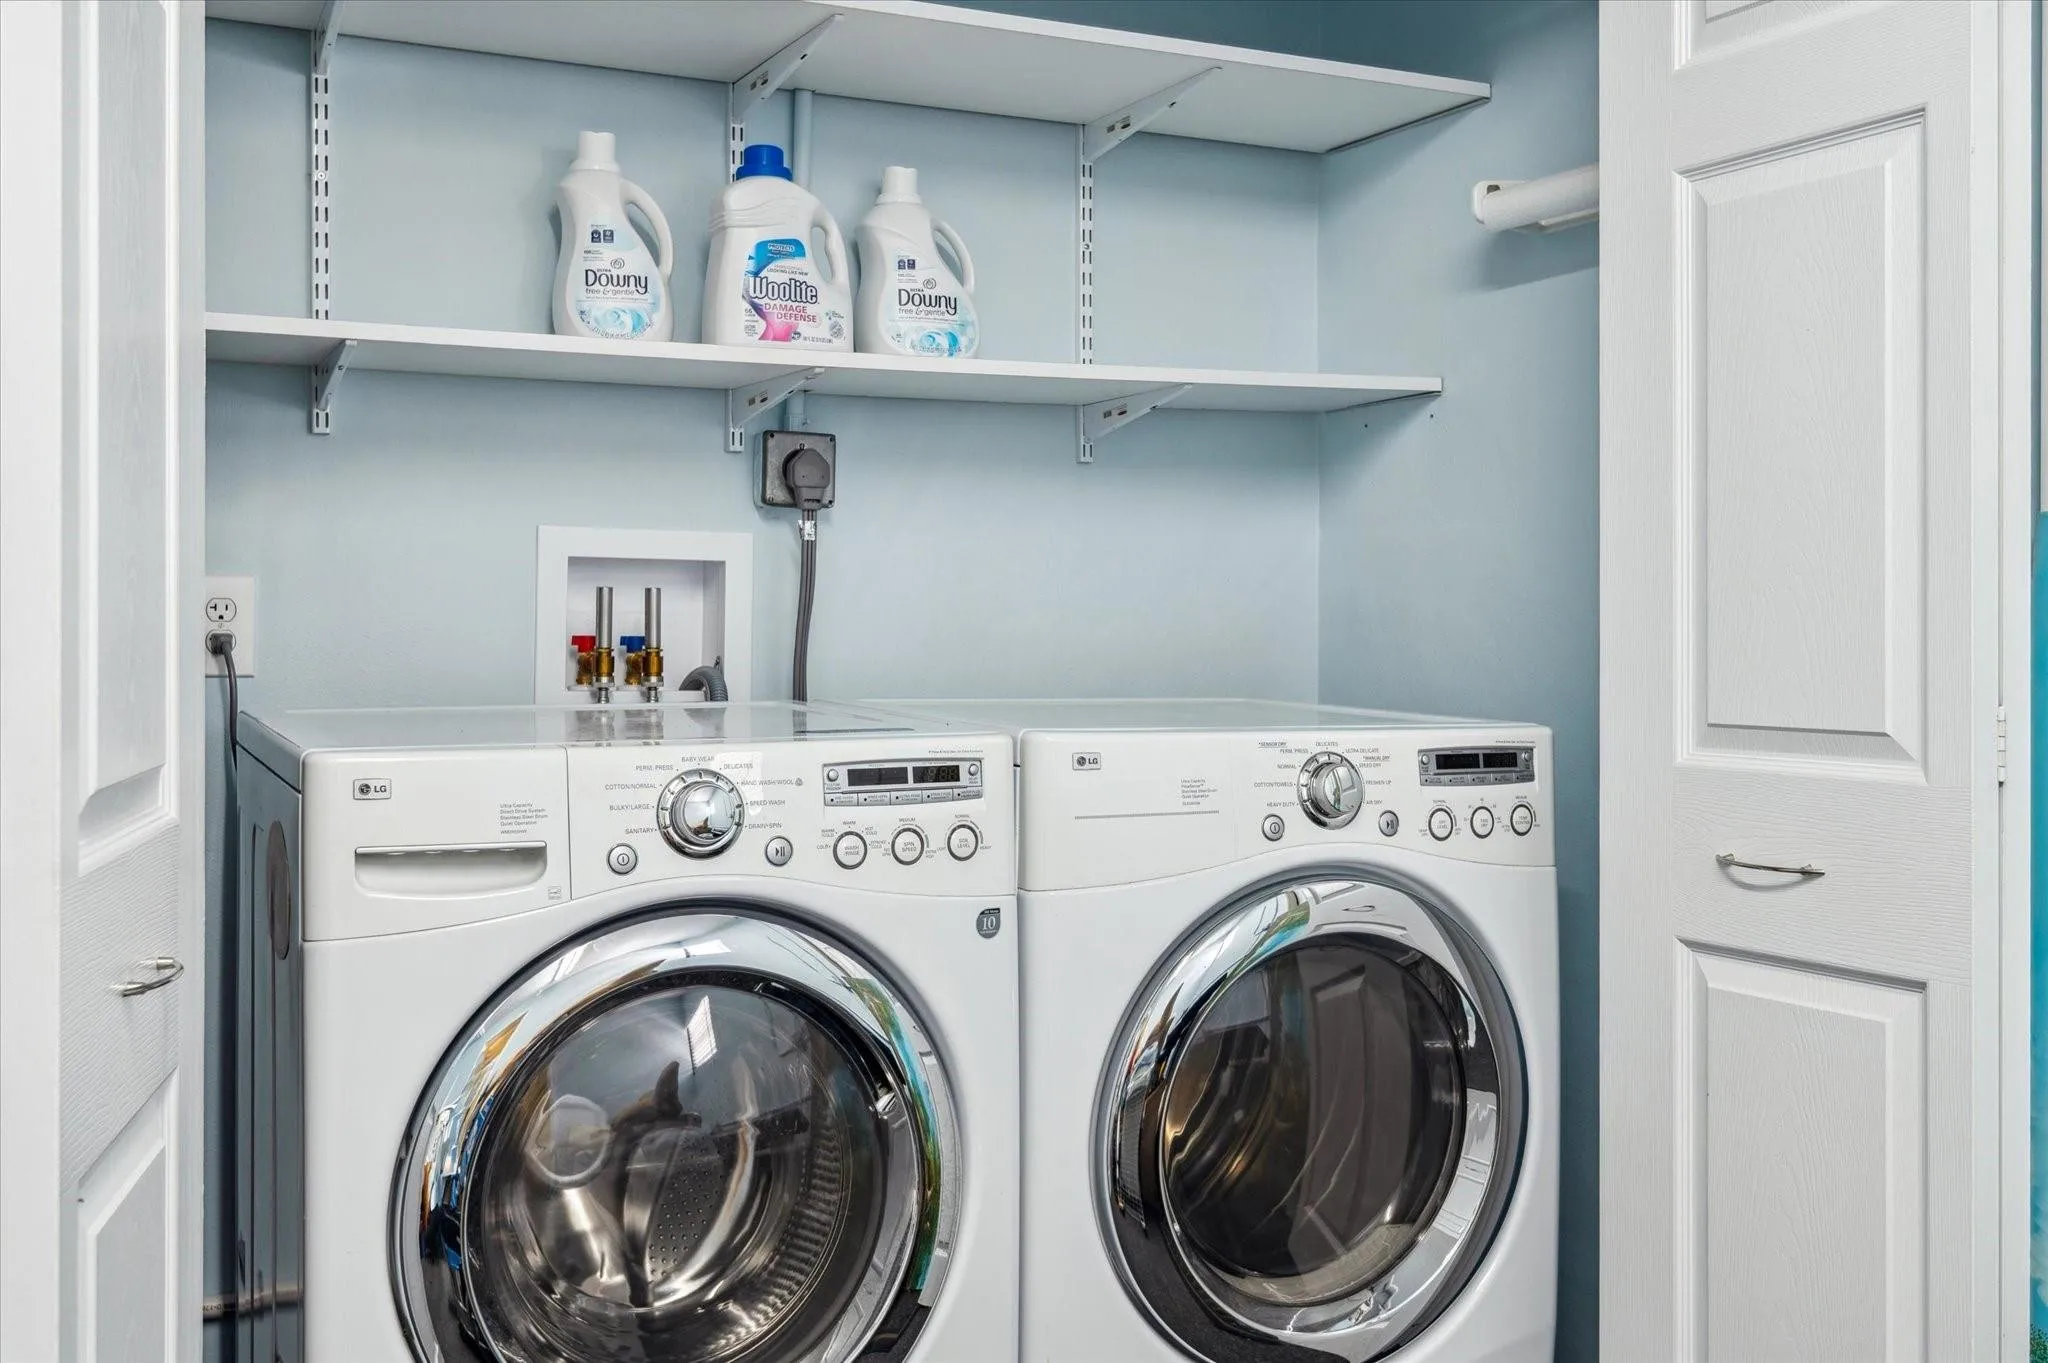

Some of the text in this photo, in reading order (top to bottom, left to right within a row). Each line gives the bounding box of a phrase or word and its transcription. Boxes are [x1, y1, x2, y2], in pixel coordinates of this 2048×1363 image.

[585, 269, 648, 295] Downy
[612, 288, 635, 296] gentle
[750, 276, 818, 304] Woolite
[898, 288, 957, 316] Downy
[764, 303, 808, 314] DAMAGE
[924, 308, 946, 316] gentle
[776, 312, 817, 323] DEFENSE
[374, 785, 387, 793] LG
[984, 916, 996, 930] 10
